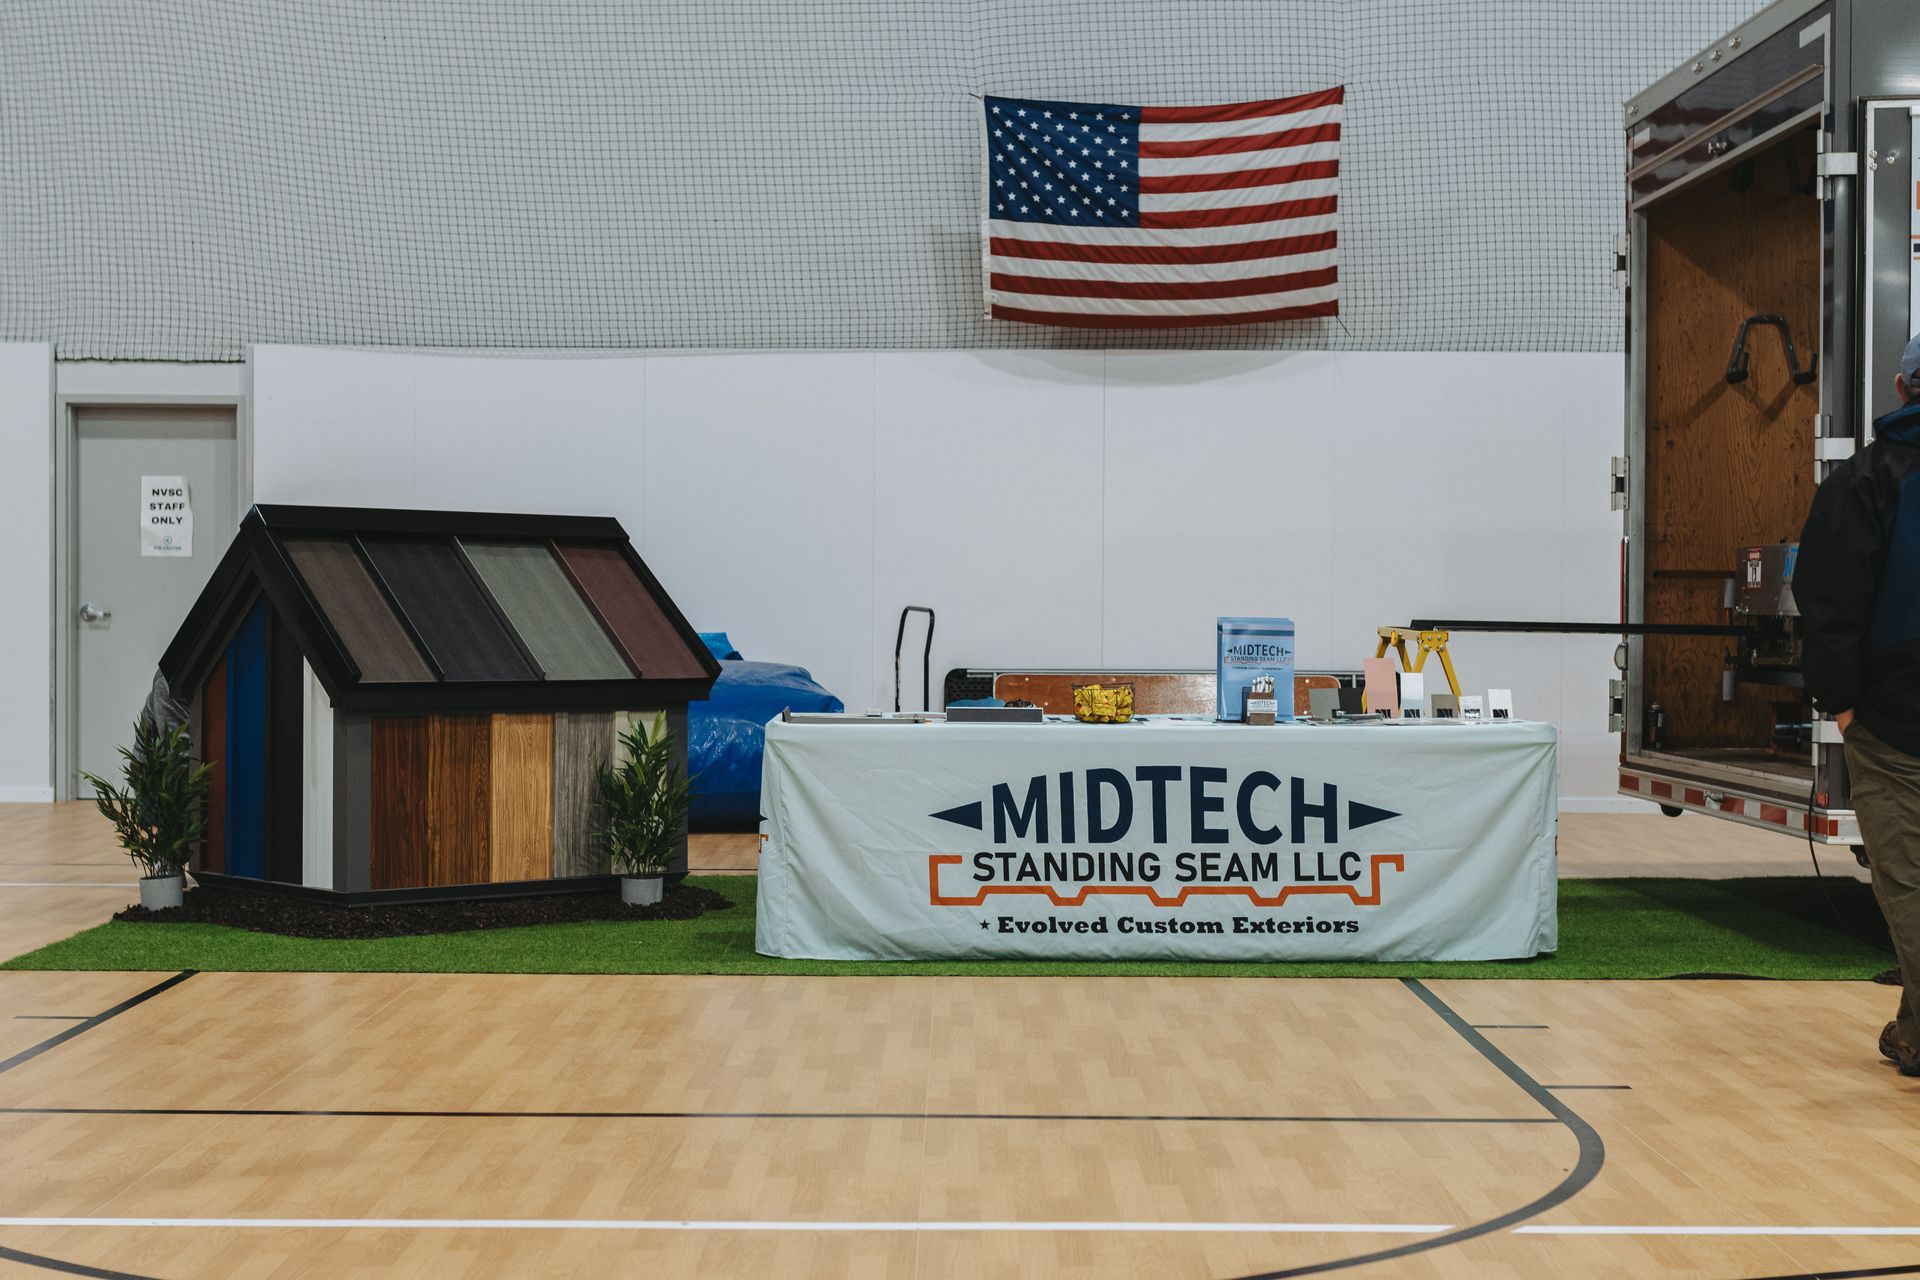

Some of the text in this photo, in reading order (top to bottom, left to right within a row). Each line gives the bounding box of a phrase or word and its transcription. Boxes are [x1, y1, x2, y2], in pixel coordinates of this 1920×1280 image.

[152, 488, 183, 497] NVSC
[149, 502, 185, 511] STAFF
[151, 516, 183, 525] ONLY
[1233, 644, 1284, 656] MIDTECH
[992, 765, 1338, 845] MIDTECH
[972, 851, 1362, 883] STANDING SEAM LLC
[997, 916, 1360, 934] Evolved Custom Exteriors
